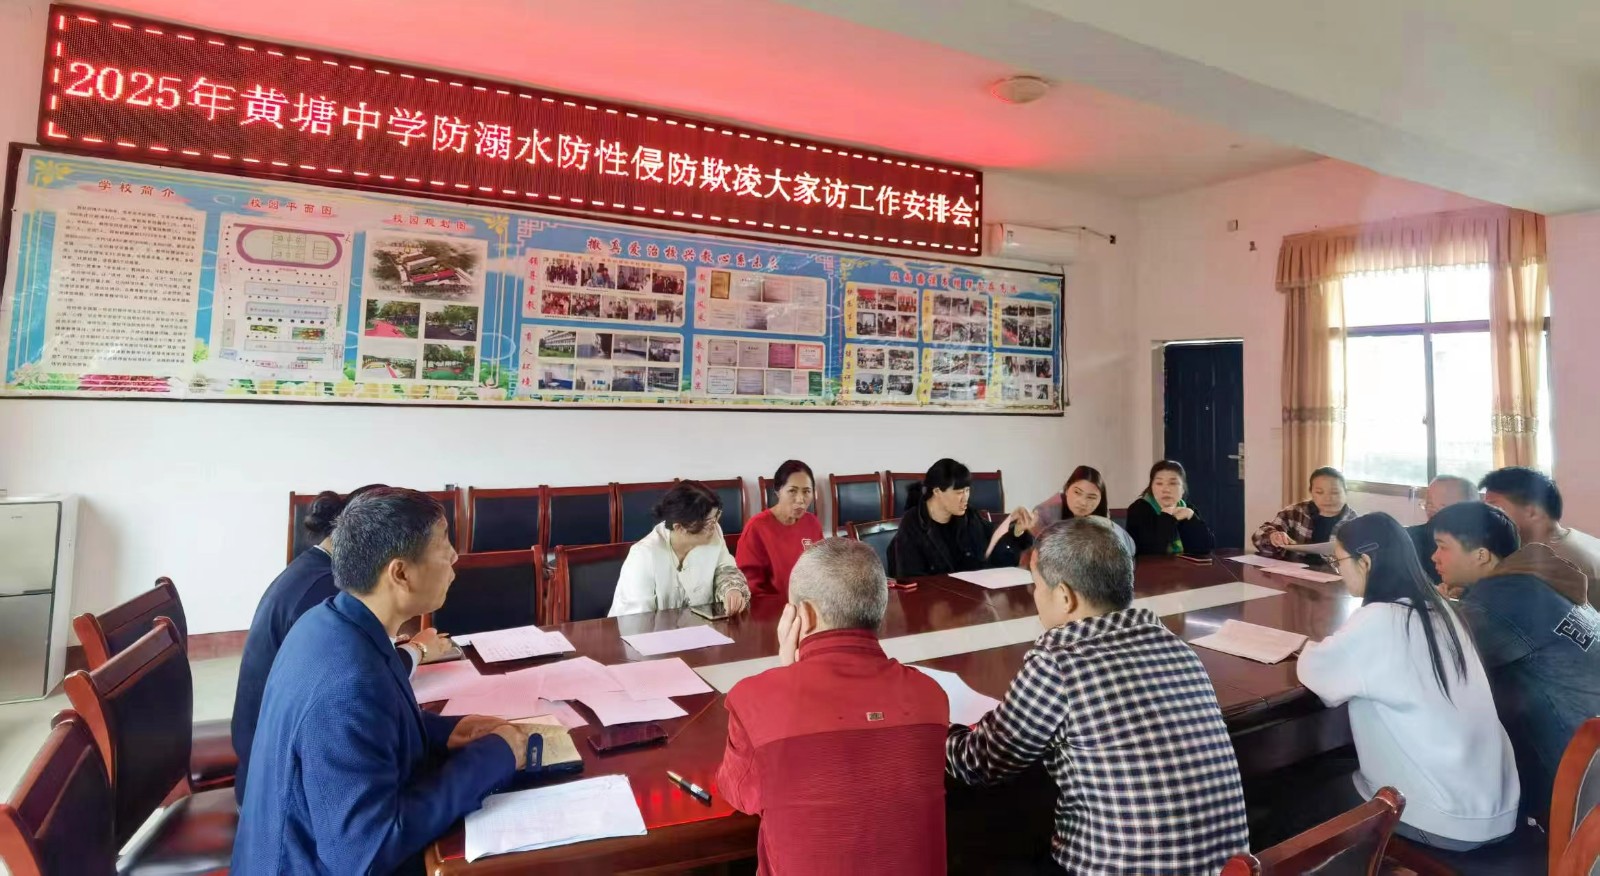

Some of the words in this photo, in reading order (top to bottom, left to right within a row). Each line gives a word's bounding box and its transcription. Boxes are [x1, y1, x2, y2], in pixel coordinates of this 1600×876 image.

[64, 61, 974, 228] 2025年黄塘中学防溺水防性侵防欺凌大家访工作安排会
[98, 179, 175, 198] 学校简介
[249, 198, 333, 215] 校园平面图
[393, 214, 467, 230] 校园规划图
